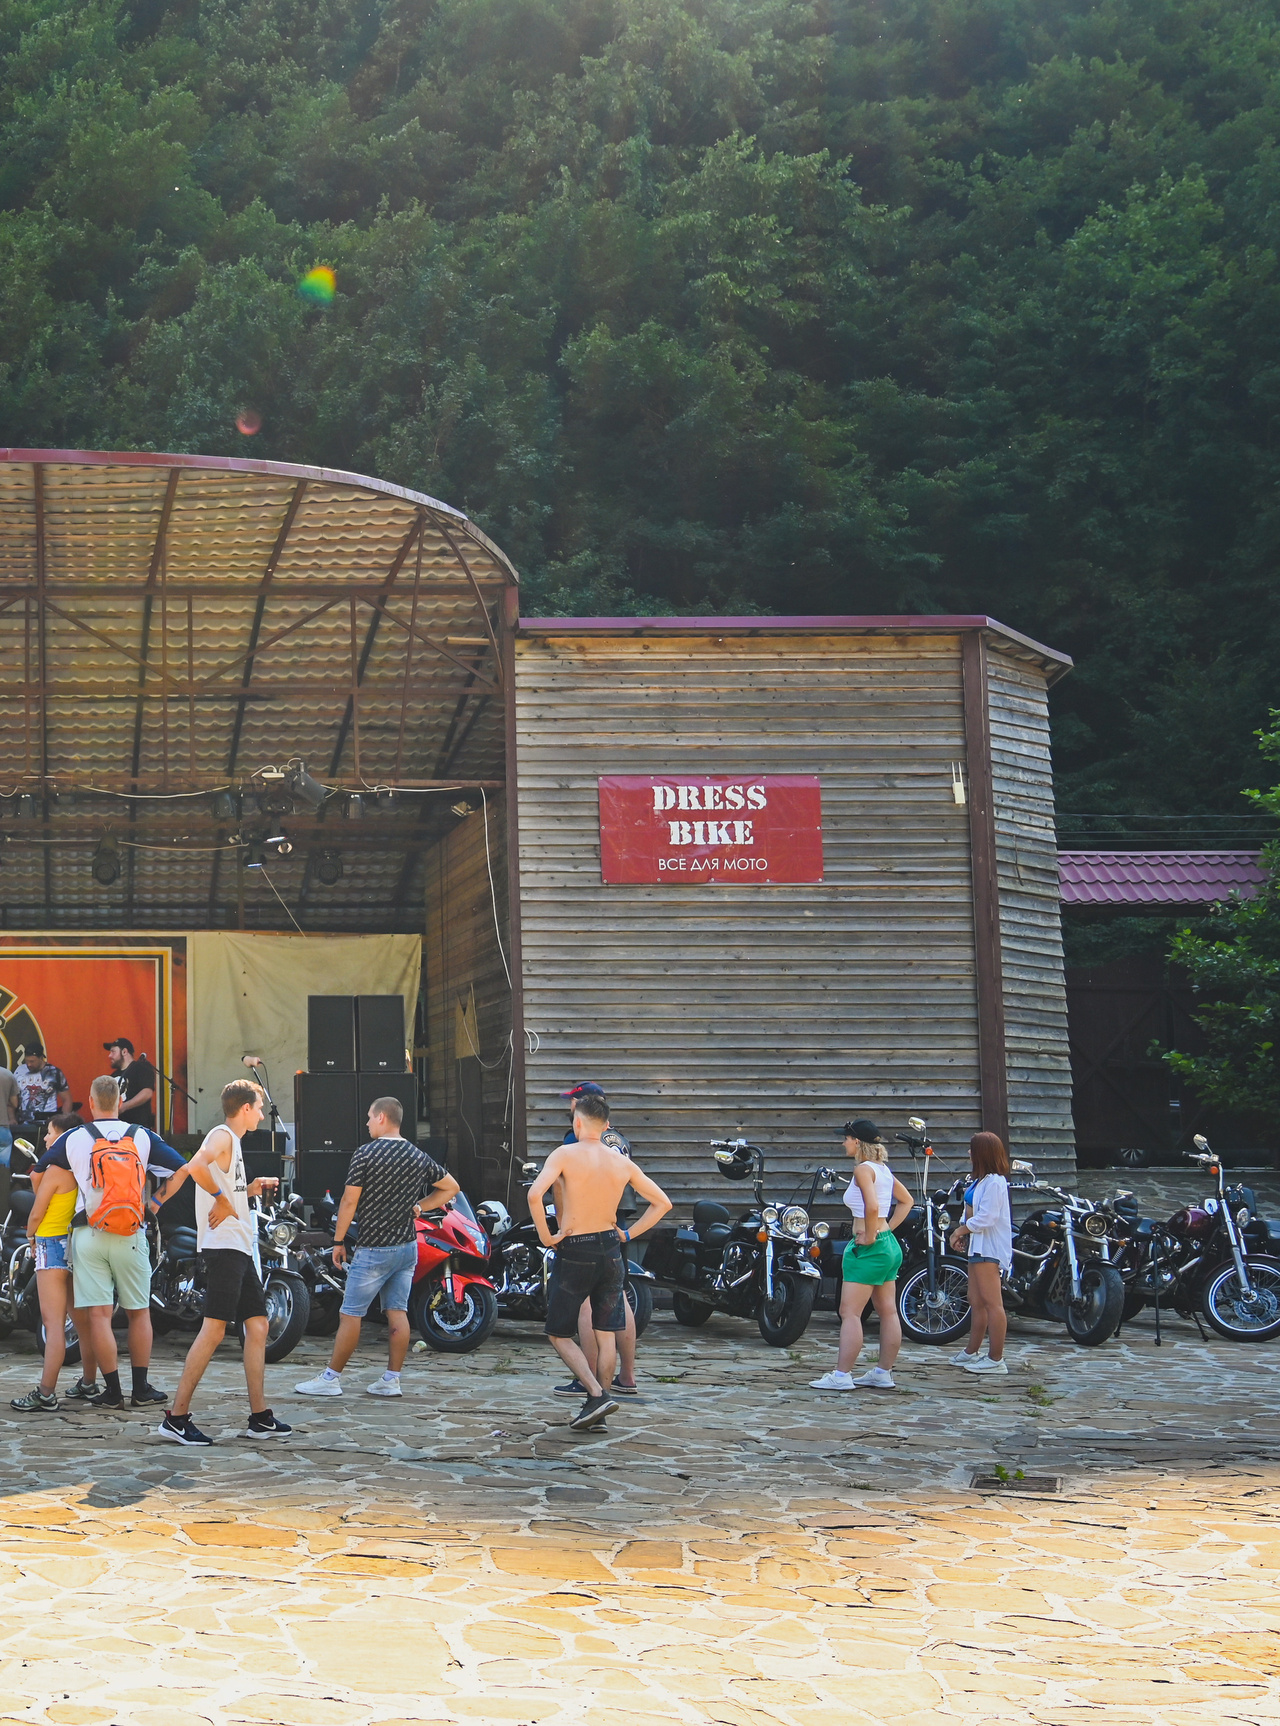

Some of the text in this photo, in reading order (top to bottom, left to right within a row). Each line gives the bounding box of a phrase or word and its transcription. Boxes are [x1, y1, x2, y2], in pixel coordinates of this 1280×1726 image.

[652, 785, 767, 810] DRESS
[668, 820, 754, 845] BIKE
[658, 858, 768, 872] ВСЕ ДЛЯ МОТО
